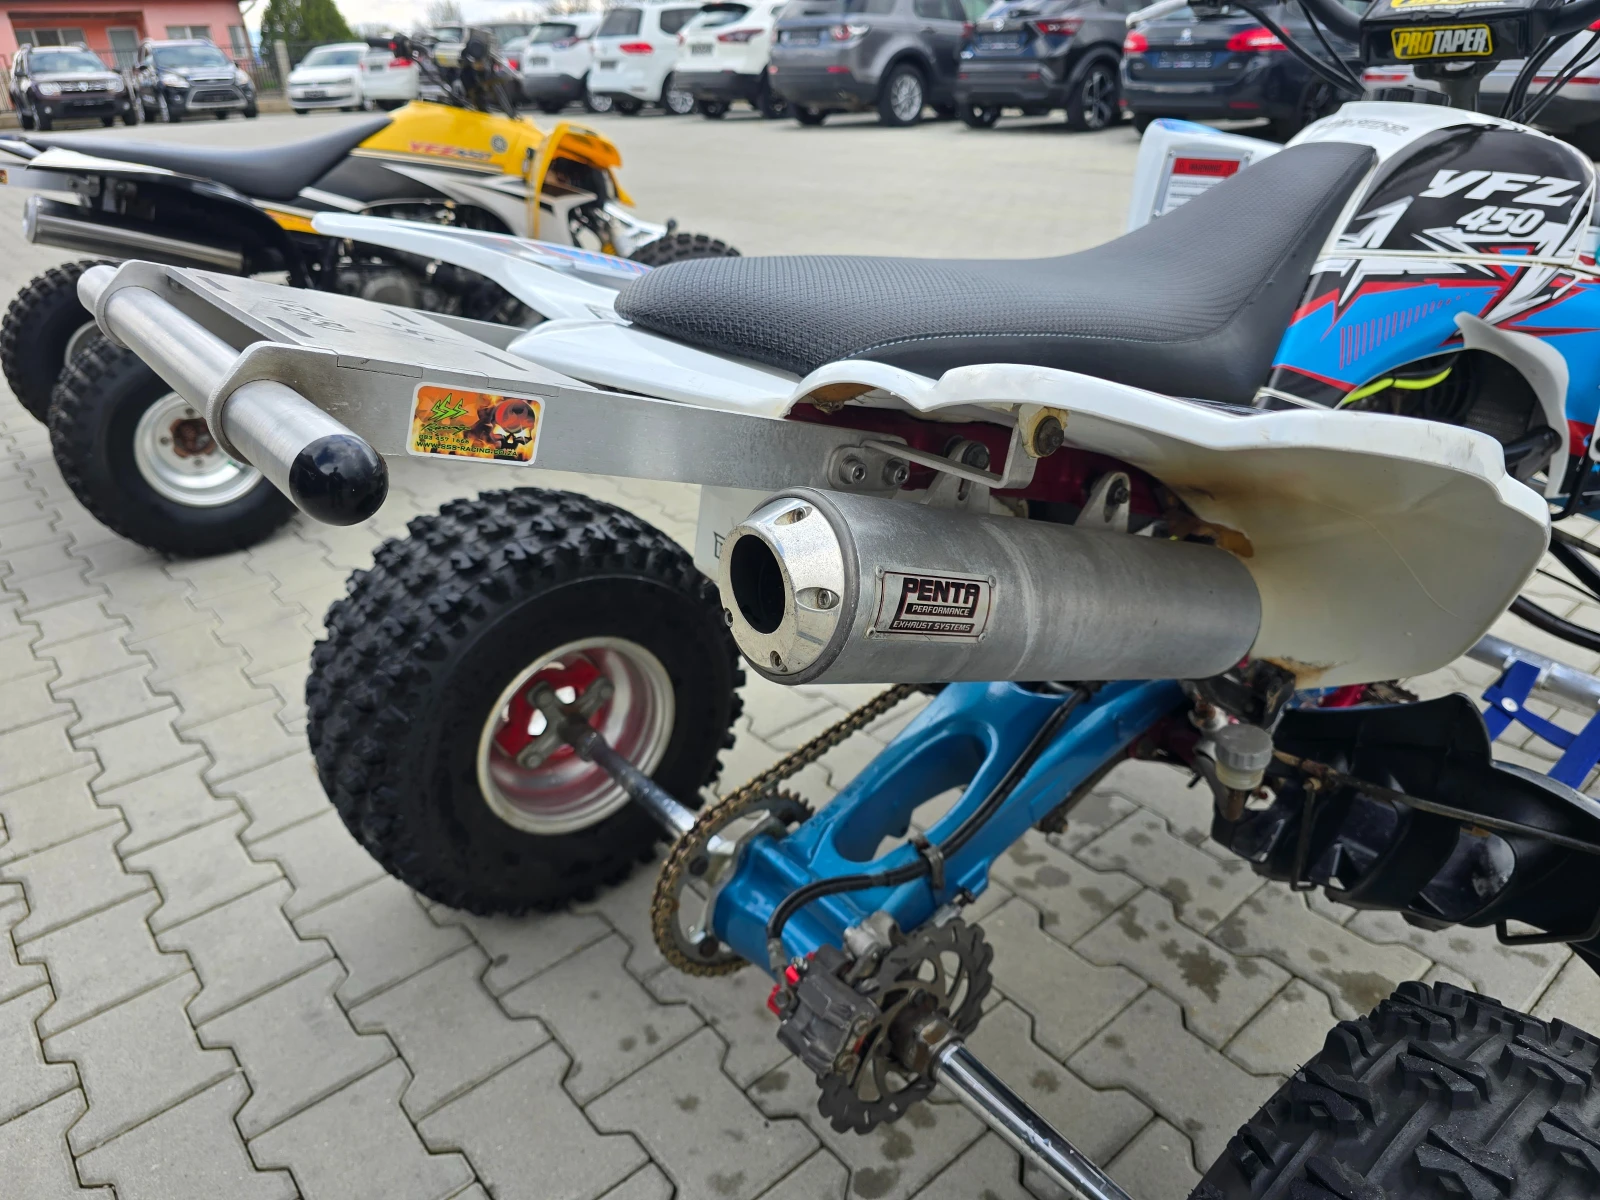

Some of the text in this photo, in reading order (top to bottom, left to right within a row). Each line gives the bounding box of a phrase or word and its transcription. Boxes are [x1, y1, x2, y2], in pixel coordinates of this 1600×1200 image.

[1397, 28, 1487, 55] PROTAPER
[1419, 169, 1581, 206] YFZ
[1456, 205, 1545, 234] 450
[899, 577, 980, 605] PENTA
[911, 605, 970, 616] PERFORMANCE
[893, 621, 971, 631] EXHAUST SYSTEMS
